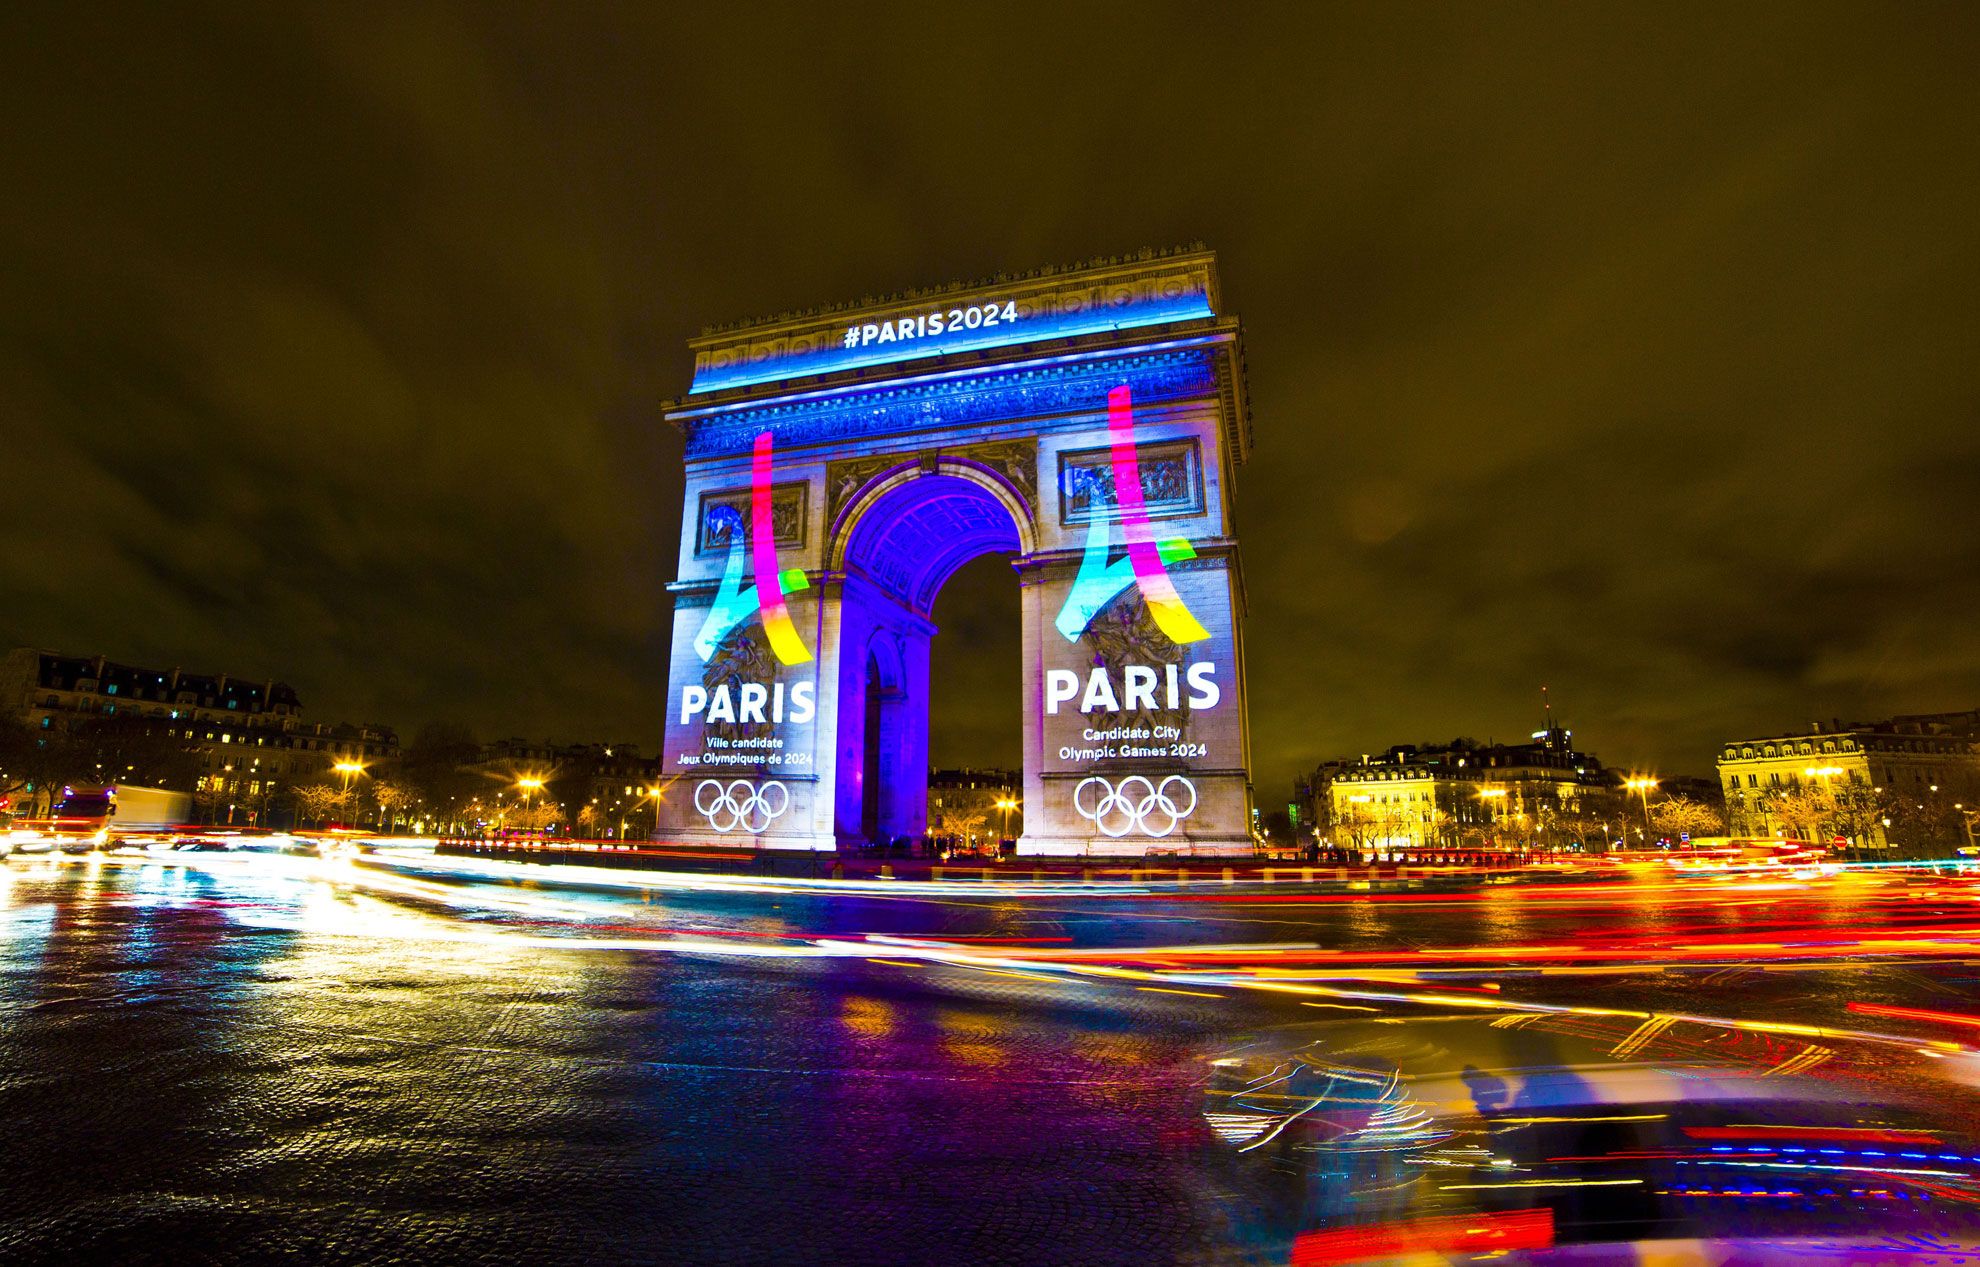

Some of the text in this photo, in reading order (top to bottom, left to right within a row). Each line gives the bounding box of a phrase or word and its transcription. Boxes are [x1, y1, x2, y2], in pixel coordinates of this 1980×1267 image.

[844, 301, 1018, 348] #PARIS2024
[1046, 662, 1221, 714] PARIS
[680, 681, 816, 725] PARIS
[1083, 726, 1180, 741] Candidate City
[707, 737, 783, 749] Ville candidate
[1059, 743, 1207, 761] Olympic Games 2024
[677, 752, 813, 766] Jeux Olympiques de 2024
